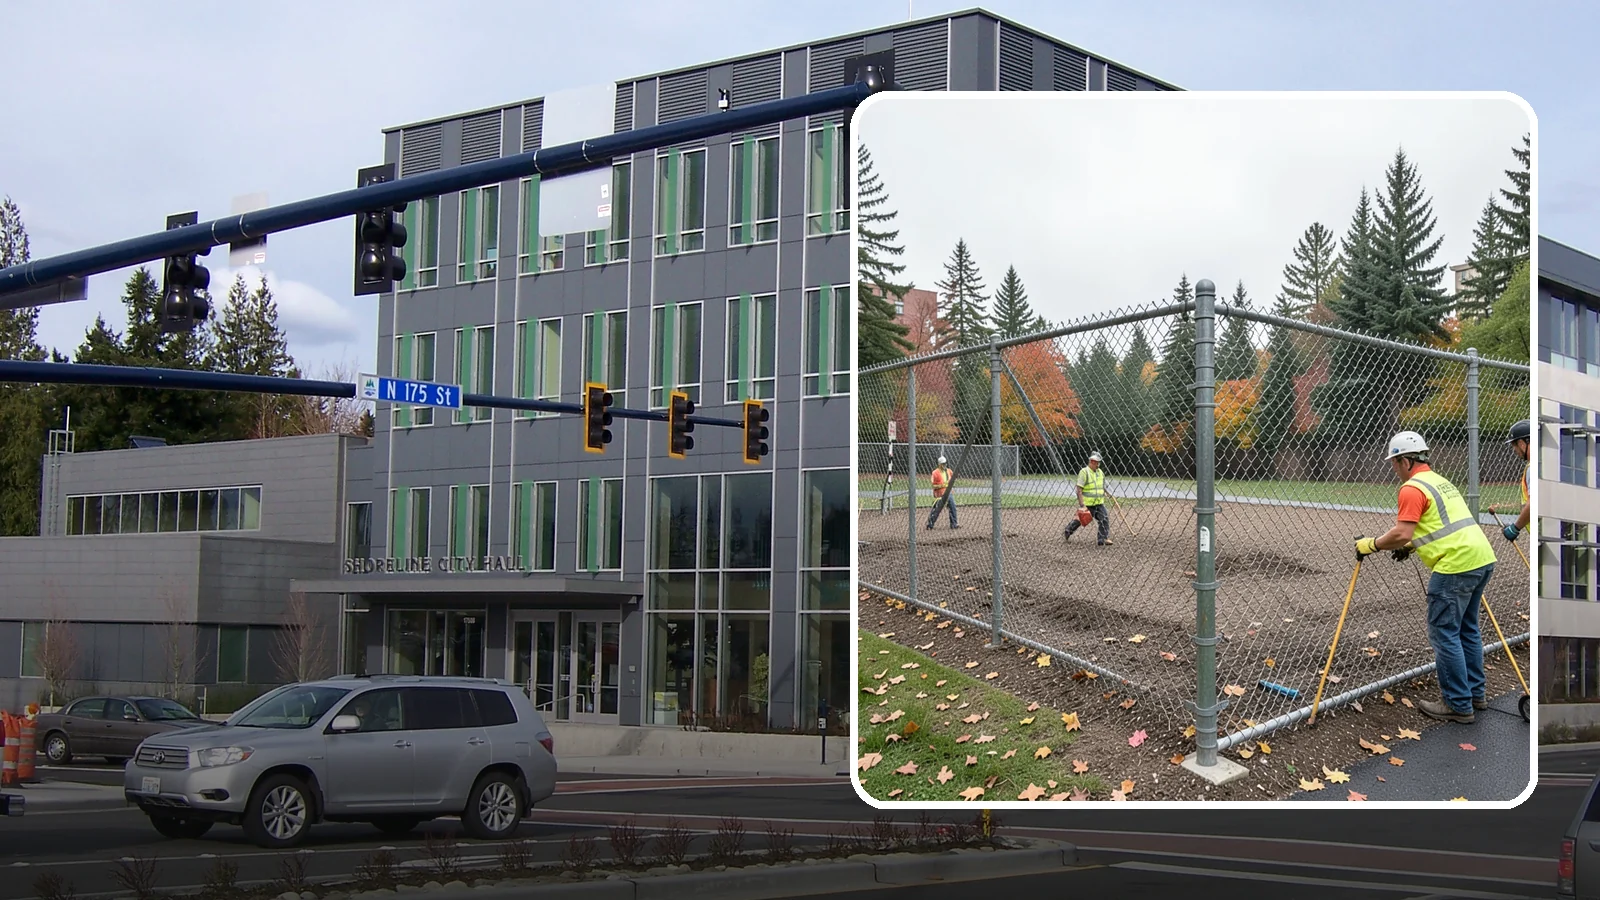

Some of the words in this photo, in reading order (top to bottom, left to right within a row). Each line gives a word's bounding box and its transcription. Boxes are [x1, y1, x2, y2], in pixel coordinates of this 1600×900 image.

[387, 380, 396, 400] N
[404, 382, 427, 403] 175
[436, 386, 451, 406] St
[344, 557, 432, 573] SHORELINE
[439, 556, 475, 572] CITY
[482, 556, 526, 572] HALL
